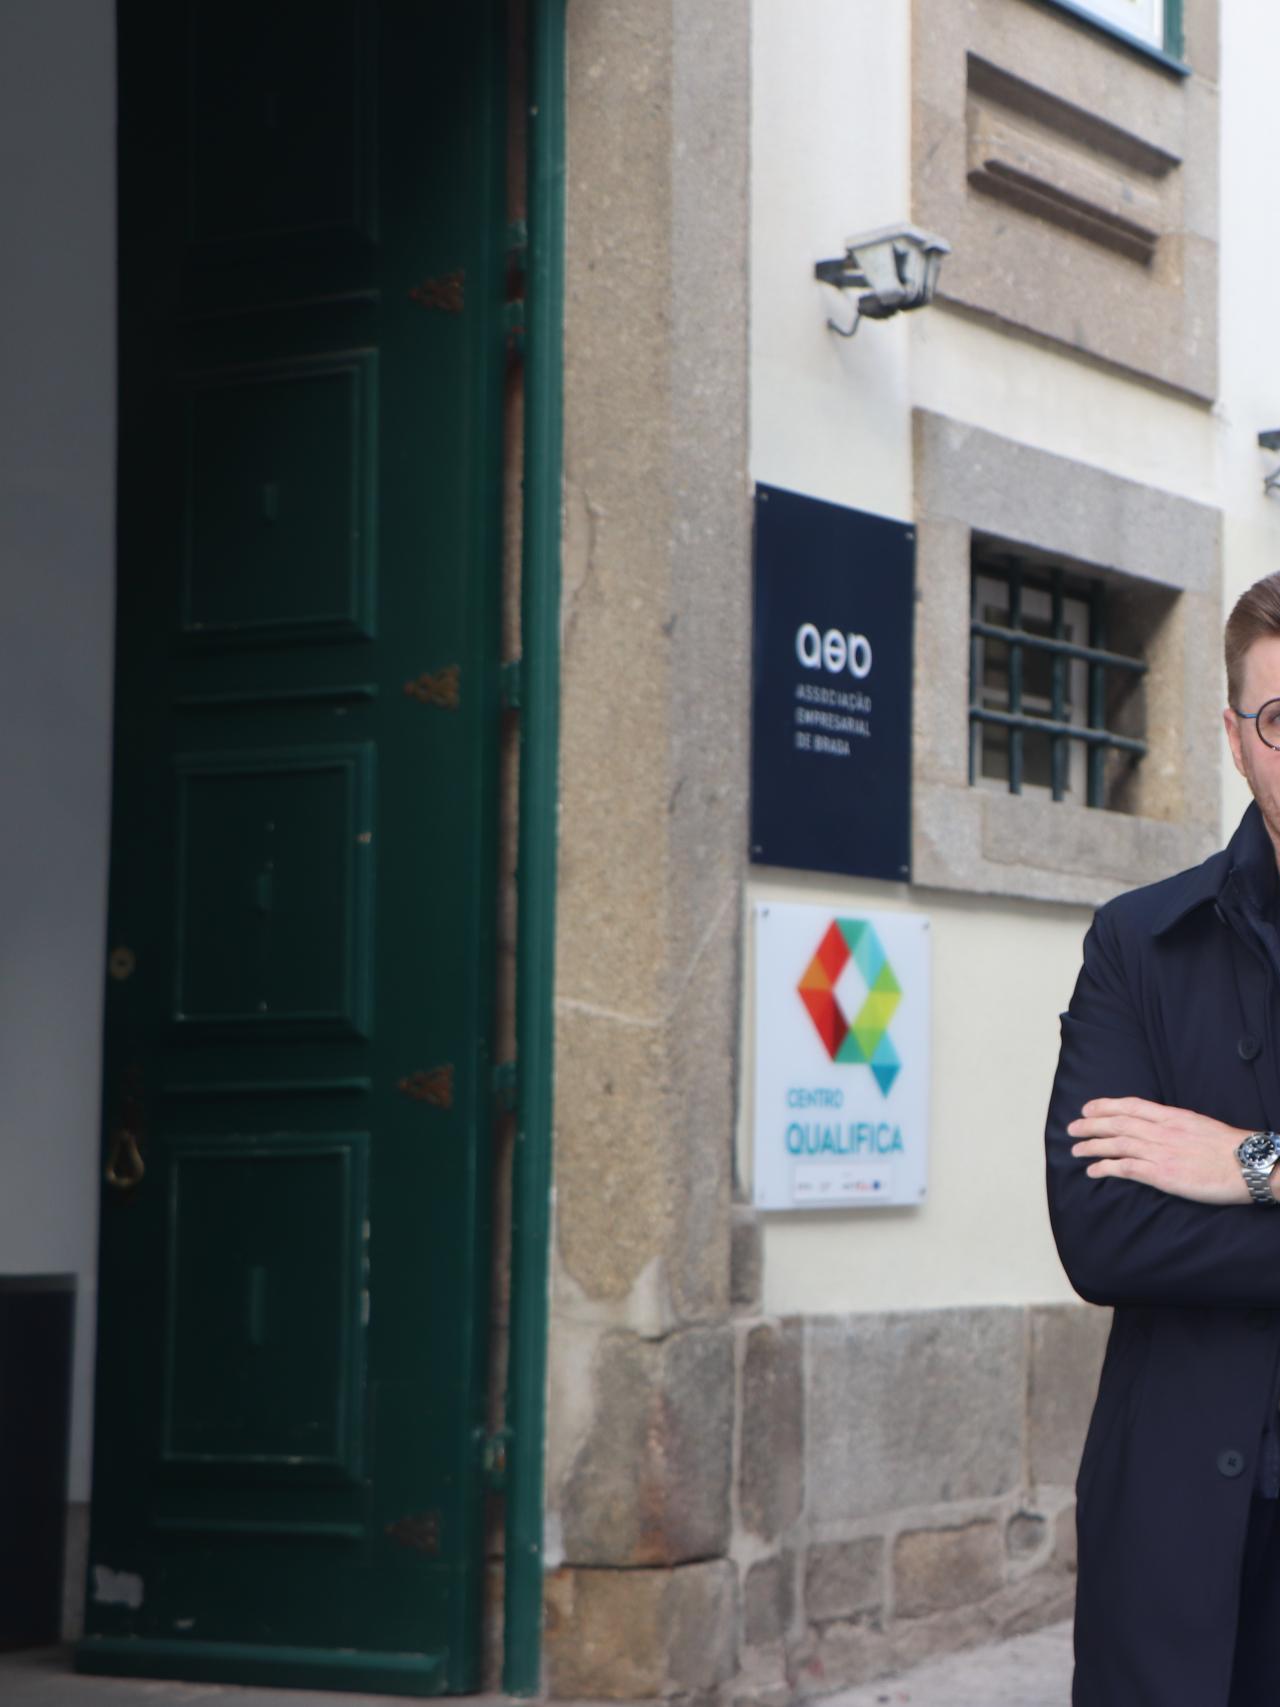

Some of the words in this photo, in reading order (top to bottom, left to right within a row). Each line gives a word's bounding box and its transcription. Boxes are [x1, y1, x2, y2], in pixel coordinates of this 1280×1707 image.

[795, 683, 872, 713] ASSOCIAÇÃO
[795, 707, 871, 737] EMPRESARIAL
[795, 731, 811, 750] DE
[813, 734, 851, 756] BRAGA
[787, 1088, 844, 1109] CENTRO
[785, 1122, 905, 1156] QUALIFICA
